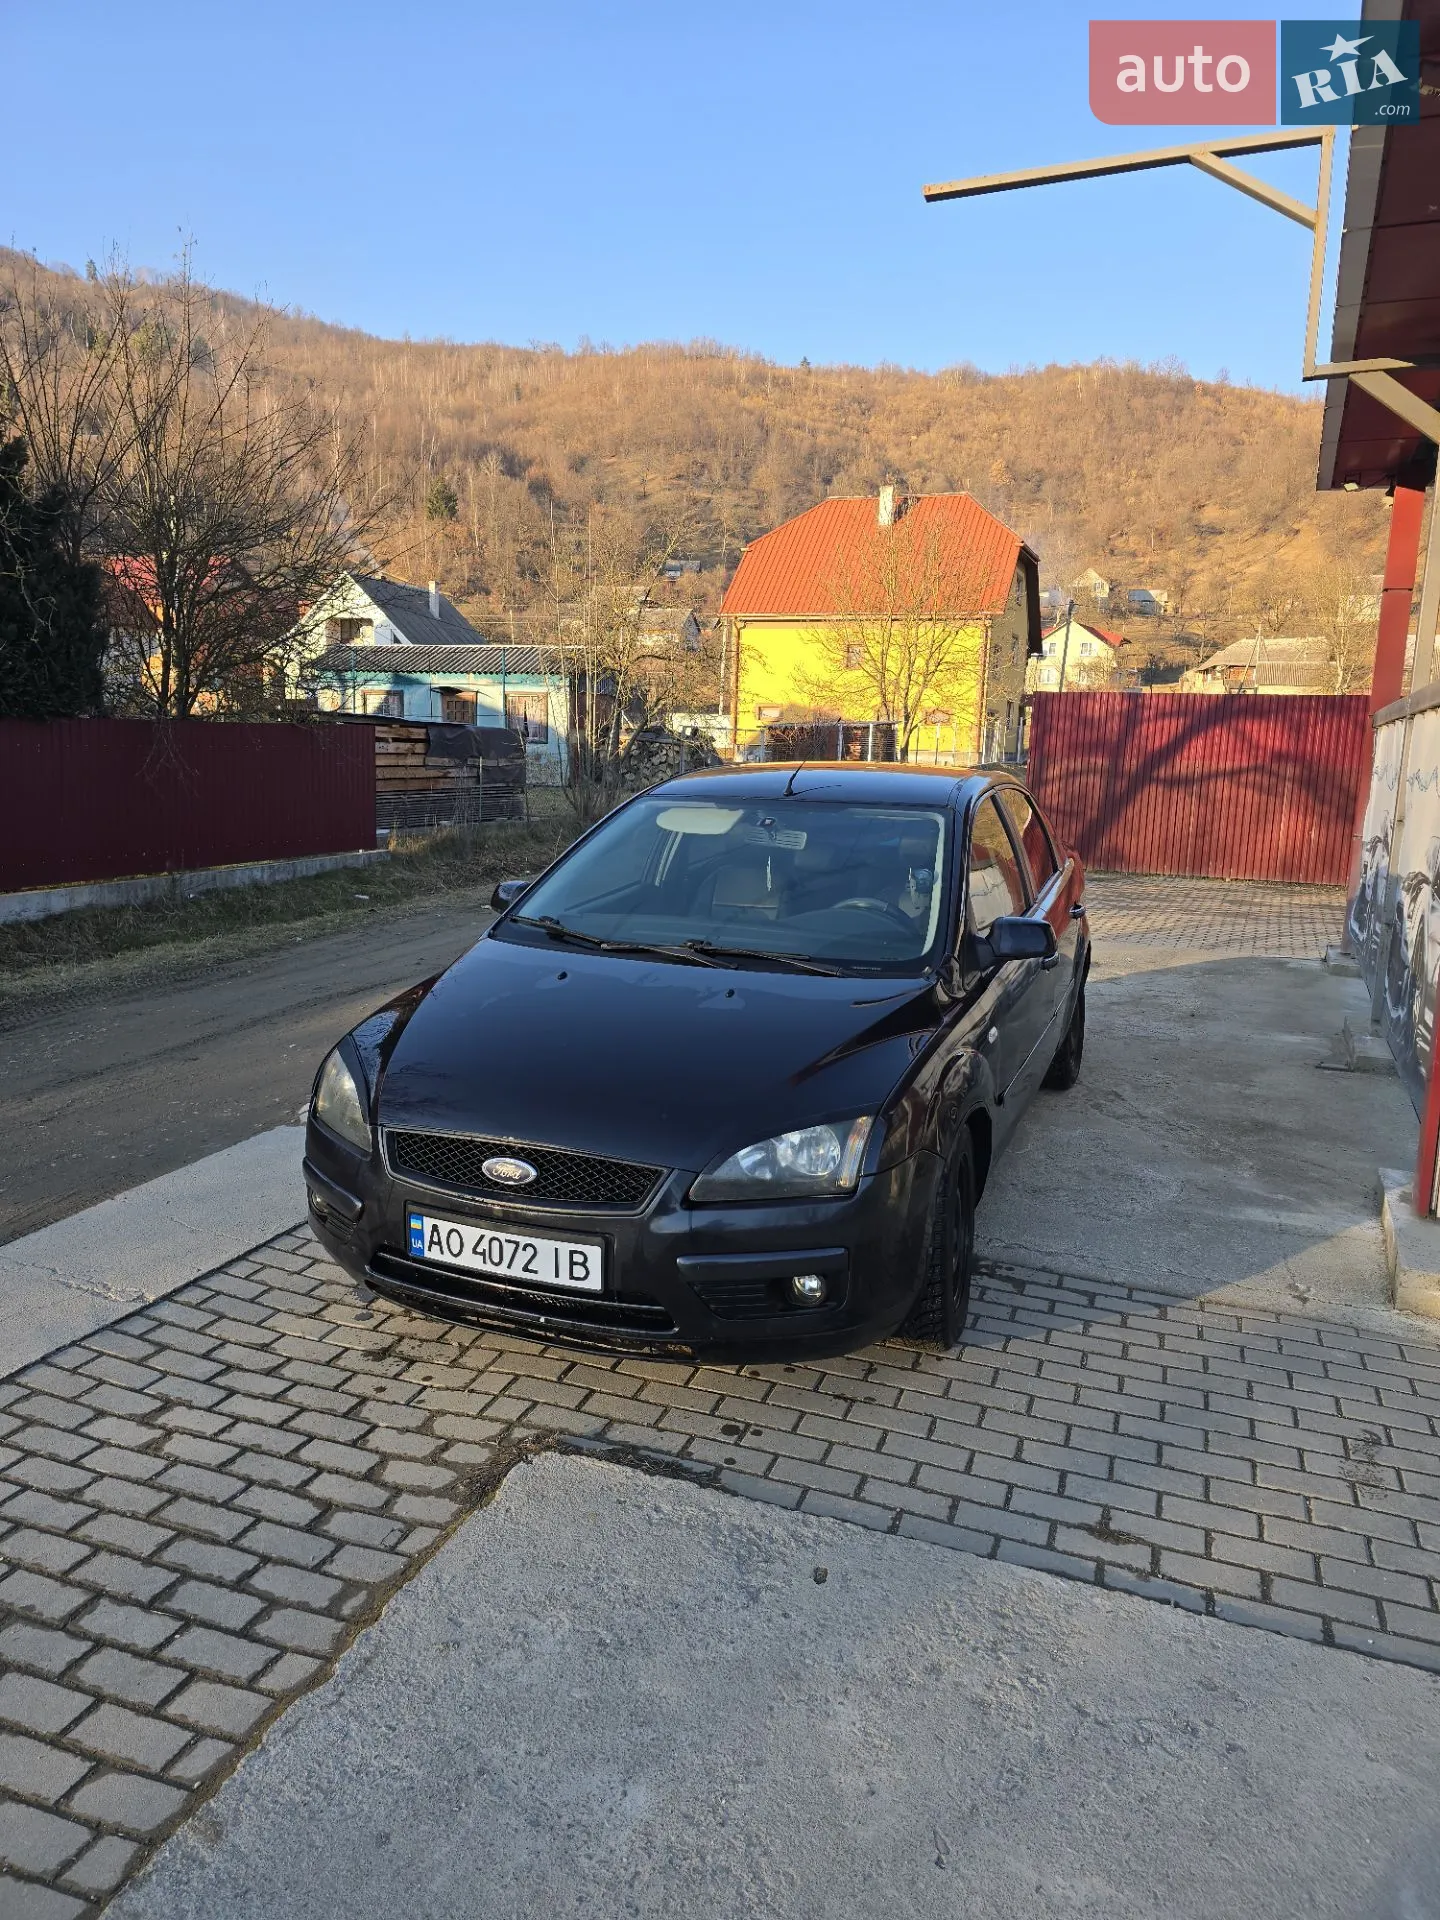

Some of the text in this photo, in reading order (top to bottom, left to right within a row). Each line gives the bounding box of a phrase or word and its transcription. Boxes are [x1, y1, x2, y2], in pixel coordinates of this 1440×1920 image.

[492, 1162, 522, 1180] Ford
[411, 1238, 424, 1250] UA
[427, 1223, 590, 1282] AO 4072 IB
